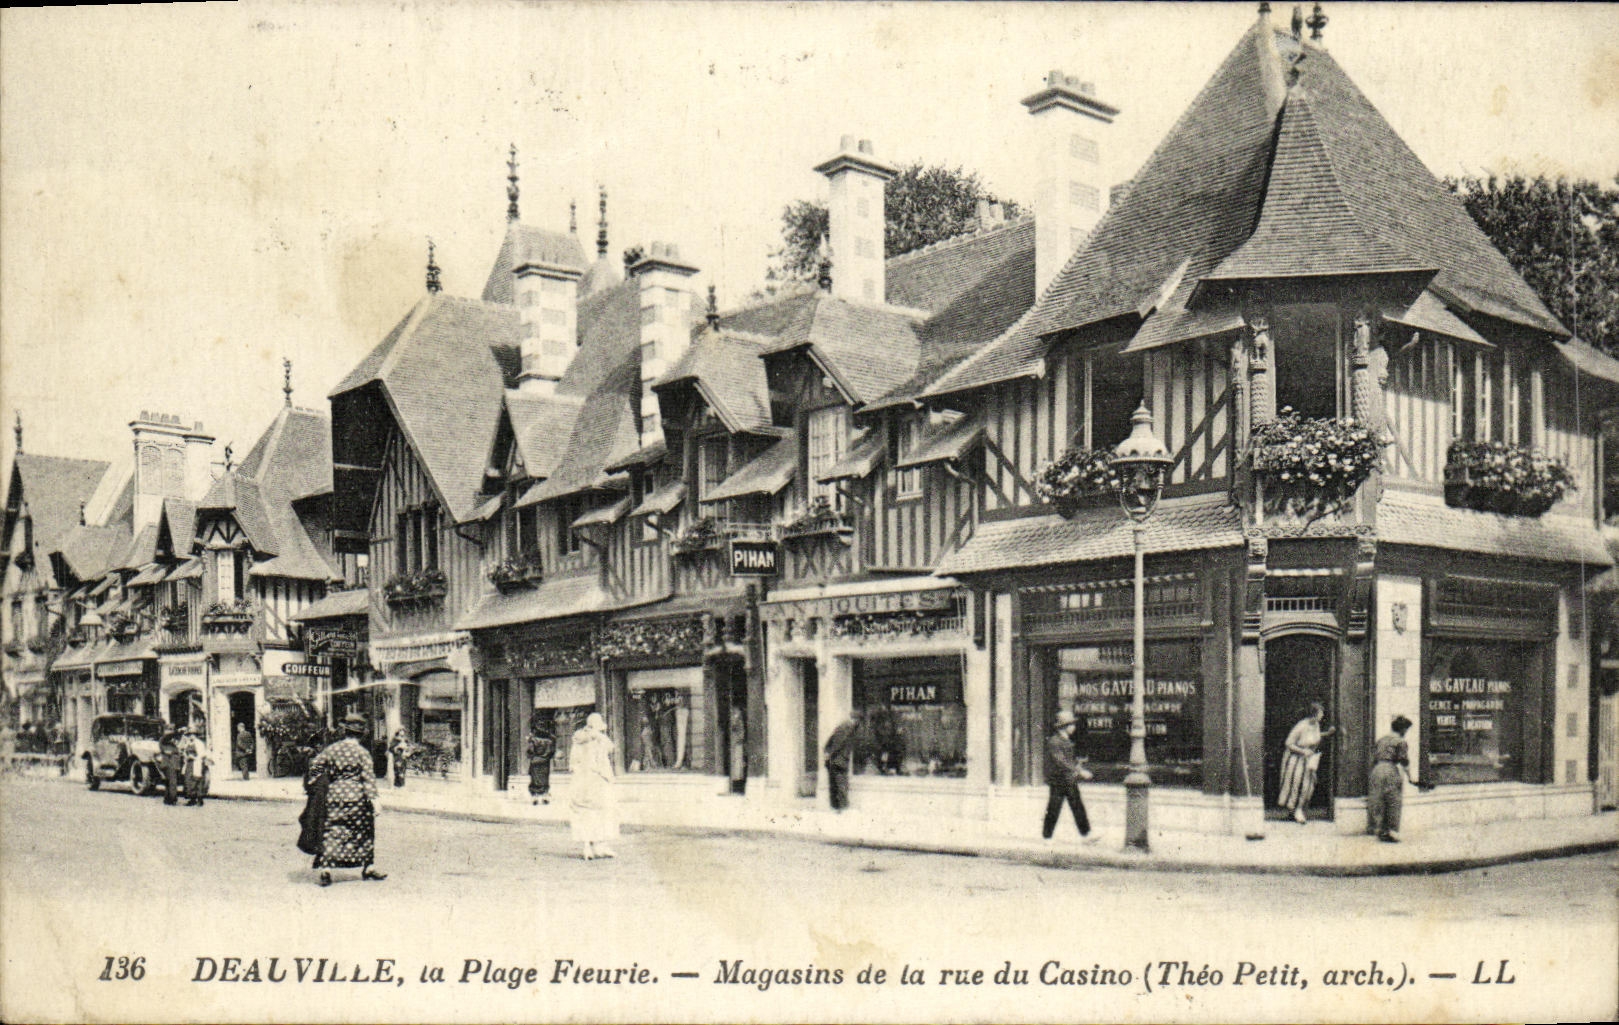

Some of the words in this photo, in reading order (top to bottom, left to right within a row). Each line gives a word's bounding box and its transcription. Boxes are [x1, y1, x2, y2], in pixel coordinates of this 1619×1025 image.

[734, 550, 775, 568] PIHAN
[285, 663, 330, 676] COIFFEUR
[890, 686, 936, 701] PIHAN
[1101, 680, 1154, 696] GAVEU
[1157, 681, 1196, 697] PIANOS
[1087, 718, 1113, 729] VENTE
